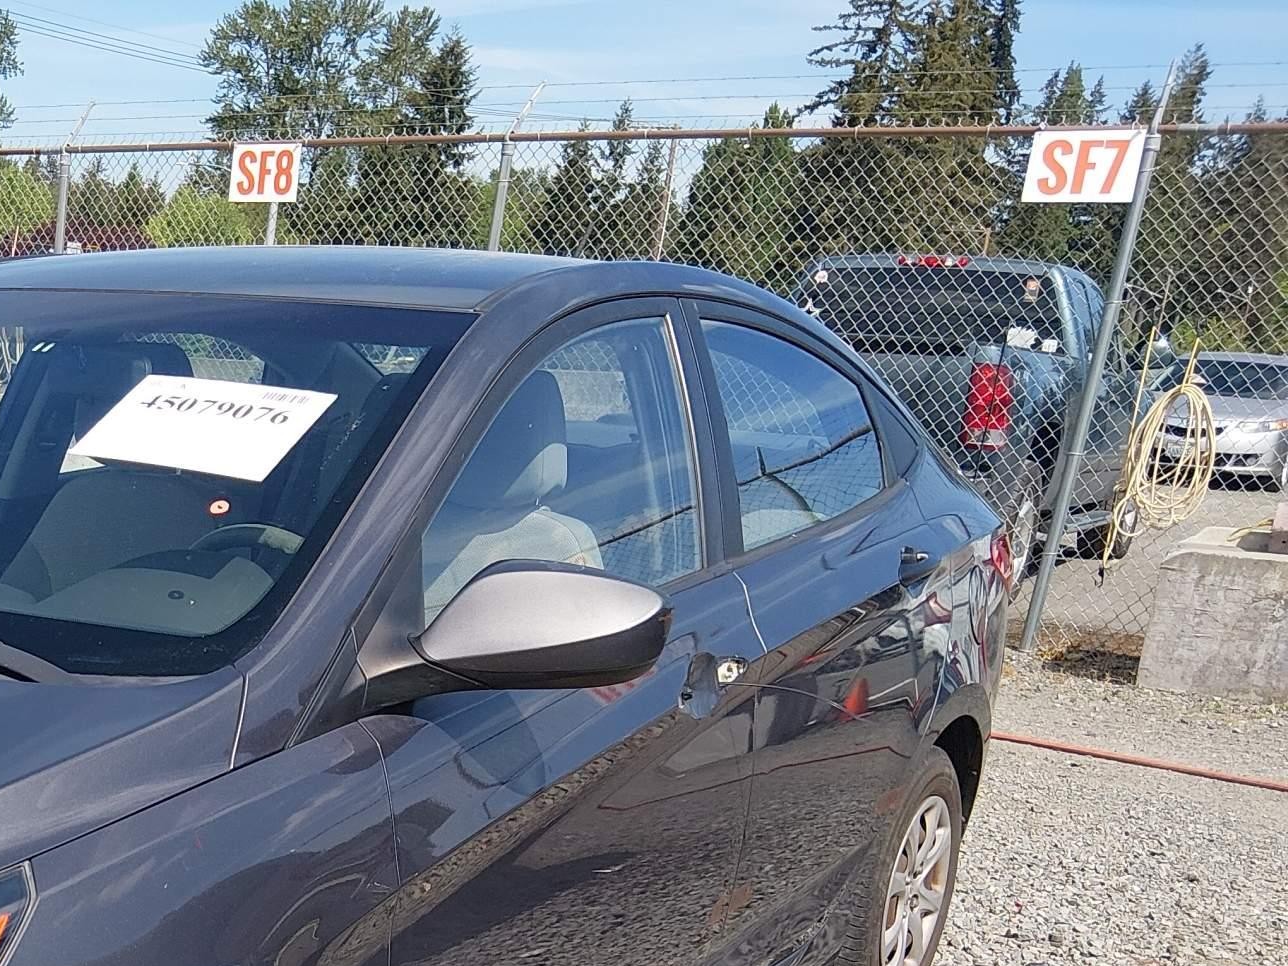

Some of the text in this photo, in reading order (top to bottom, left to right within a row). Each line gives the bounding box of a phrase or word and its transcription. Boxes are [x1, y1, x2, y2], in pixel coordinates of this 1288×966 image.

[236, 150, 294, 196] SF8
[1037, 139, 1131, 195] SF7
[140, 394, 291, 425] 45079076
